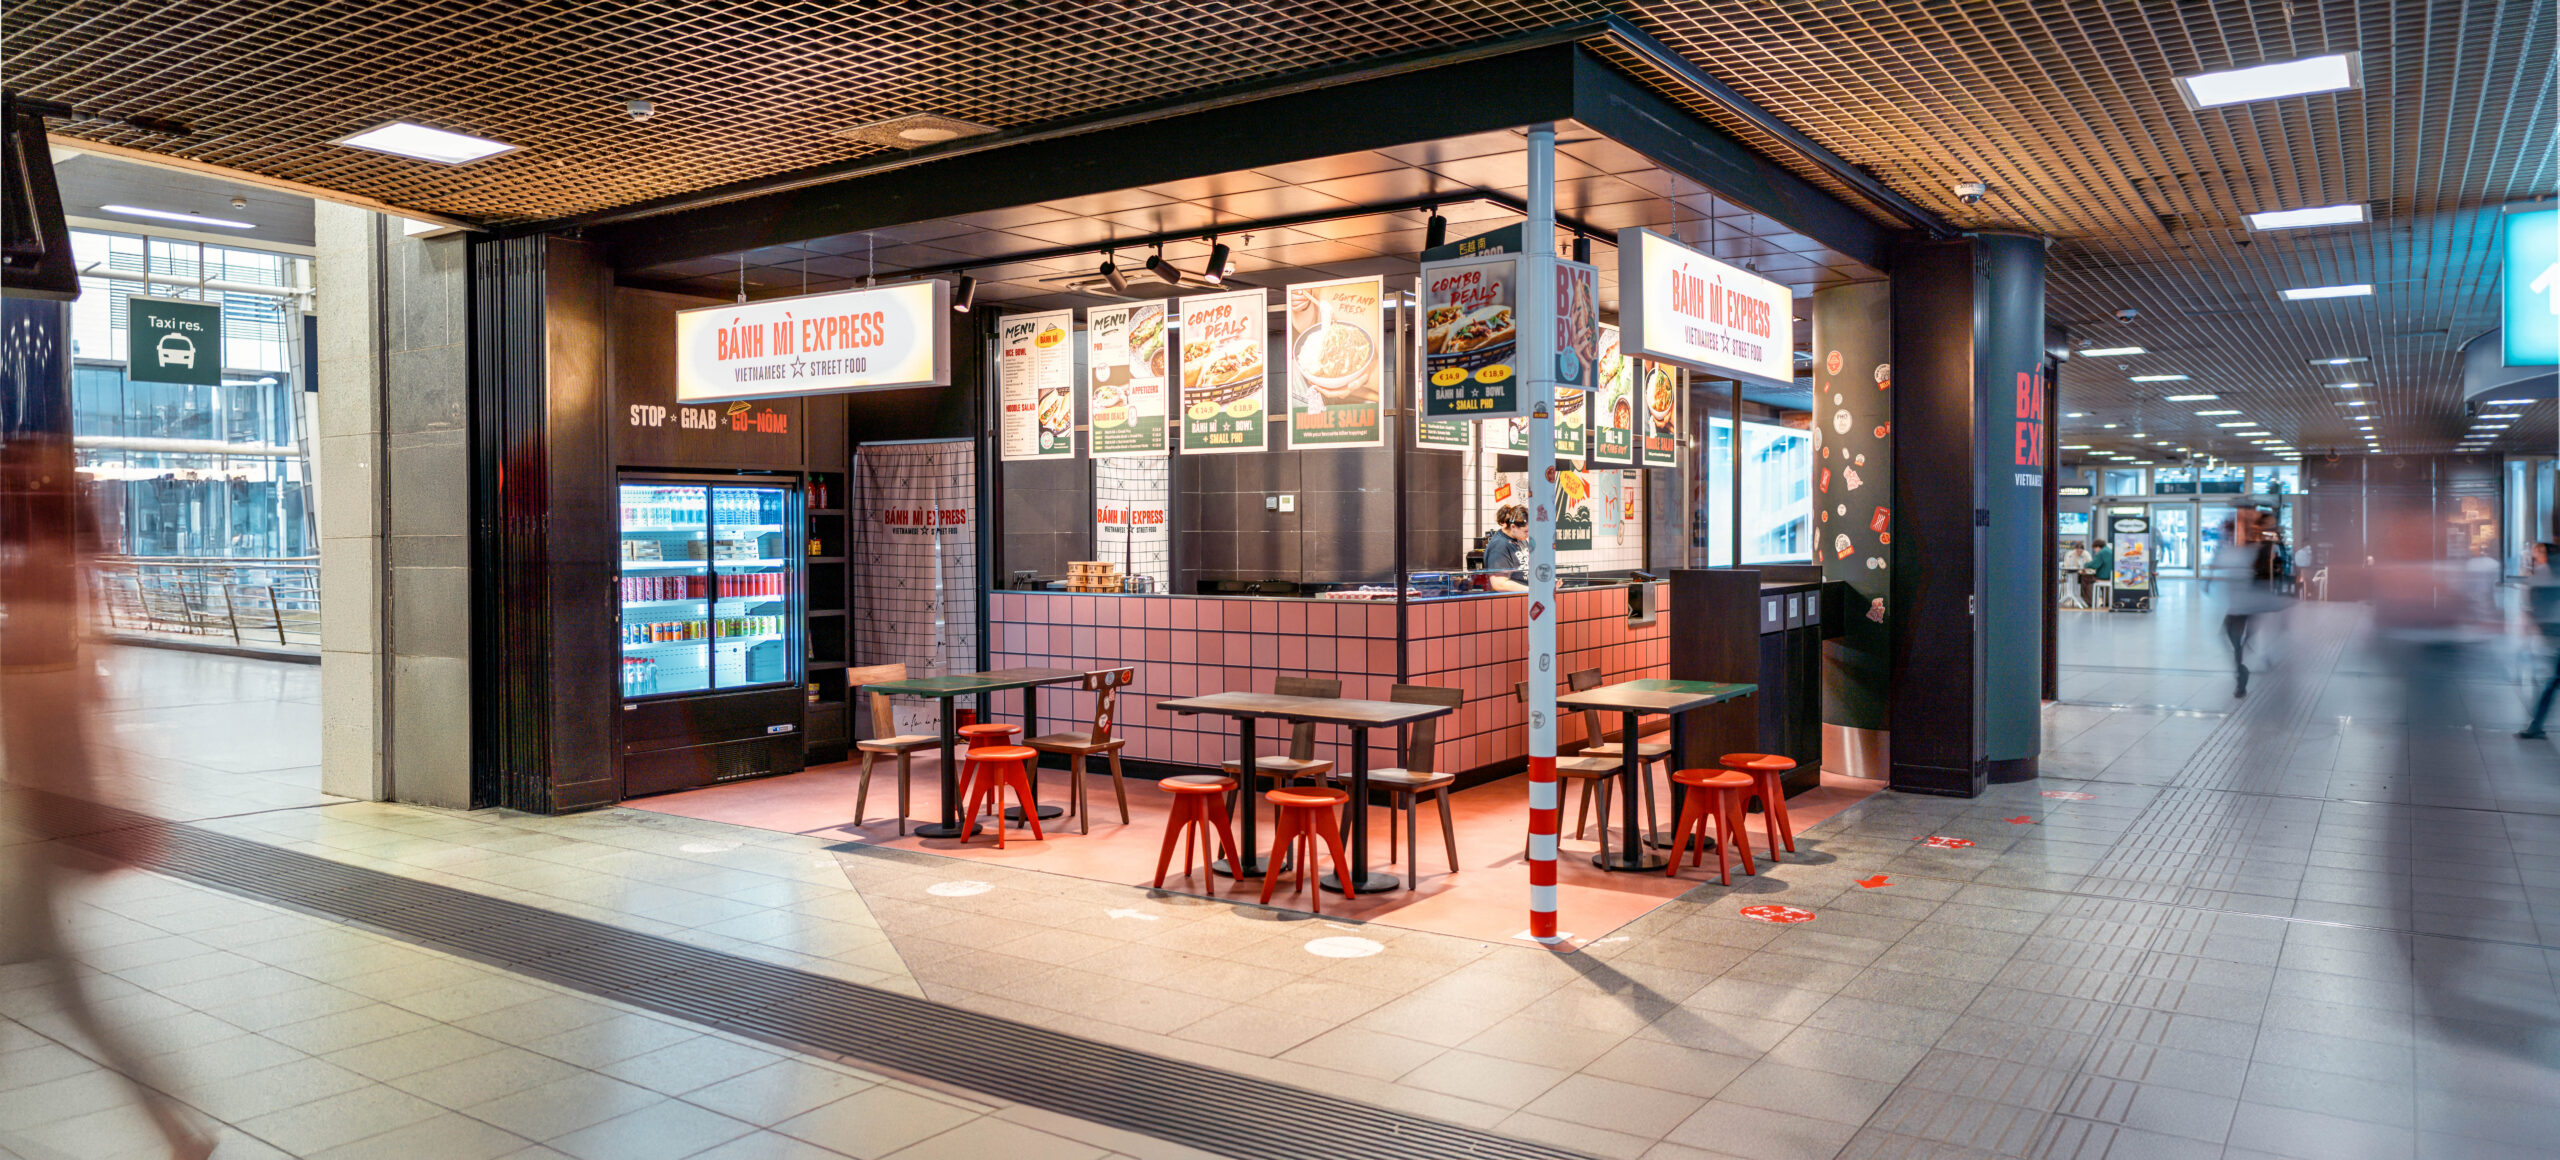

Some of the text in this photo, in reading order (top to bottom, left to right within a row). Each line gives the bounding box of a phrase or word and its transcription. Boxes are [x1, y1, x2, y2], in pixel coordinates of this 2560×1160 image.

[1431, 271, 1481, 292] COMBO
[1450, 283, 1500, 307] DEALS
[1672, 262, 1770, 339] BÁNH MÌ EXPRESS
[148, 315, 204, 332] Taxi res.
[1094, 313, 1127, 331] MENU
[1187, 304, 1232, 326] COMBO
[718, 311, 884, 361] BÁNH MÌ EXPRESS
[1005, 322, 1035, 339] MENU
[1204, 316, 1249, 340] DEALS
[1684, 325, 1763, 362] VIETNAMESE STREET FOOD
[735, 356, 867, 383] VIETNAMESE STREET FOOD
[1445, 372, 1460, 381] 14,9
[1485, 386, 1505, 397] BOWL
[1456, 399, 1478, 411] SMALL
[1480, 398, 1494, 409] PHO
[630, 404, 666, 428] STOP
[681, 408, 717, 430] GRAB
[1235, 419, 1253, 431] BOWL
[1338, 408, 1375, 428] SALAD
[1209, 433, 1229, 444] SMALL
[1230, 432, 1243, 443] PHO
[885, 506, 908, 525] BÁNH
[913, 507, 923, 525] MÌ
[1097, 505, 1164, 524] BÁNH MÌ EXPRESS
[892, 527, 919, 535] VIETNAMESE
